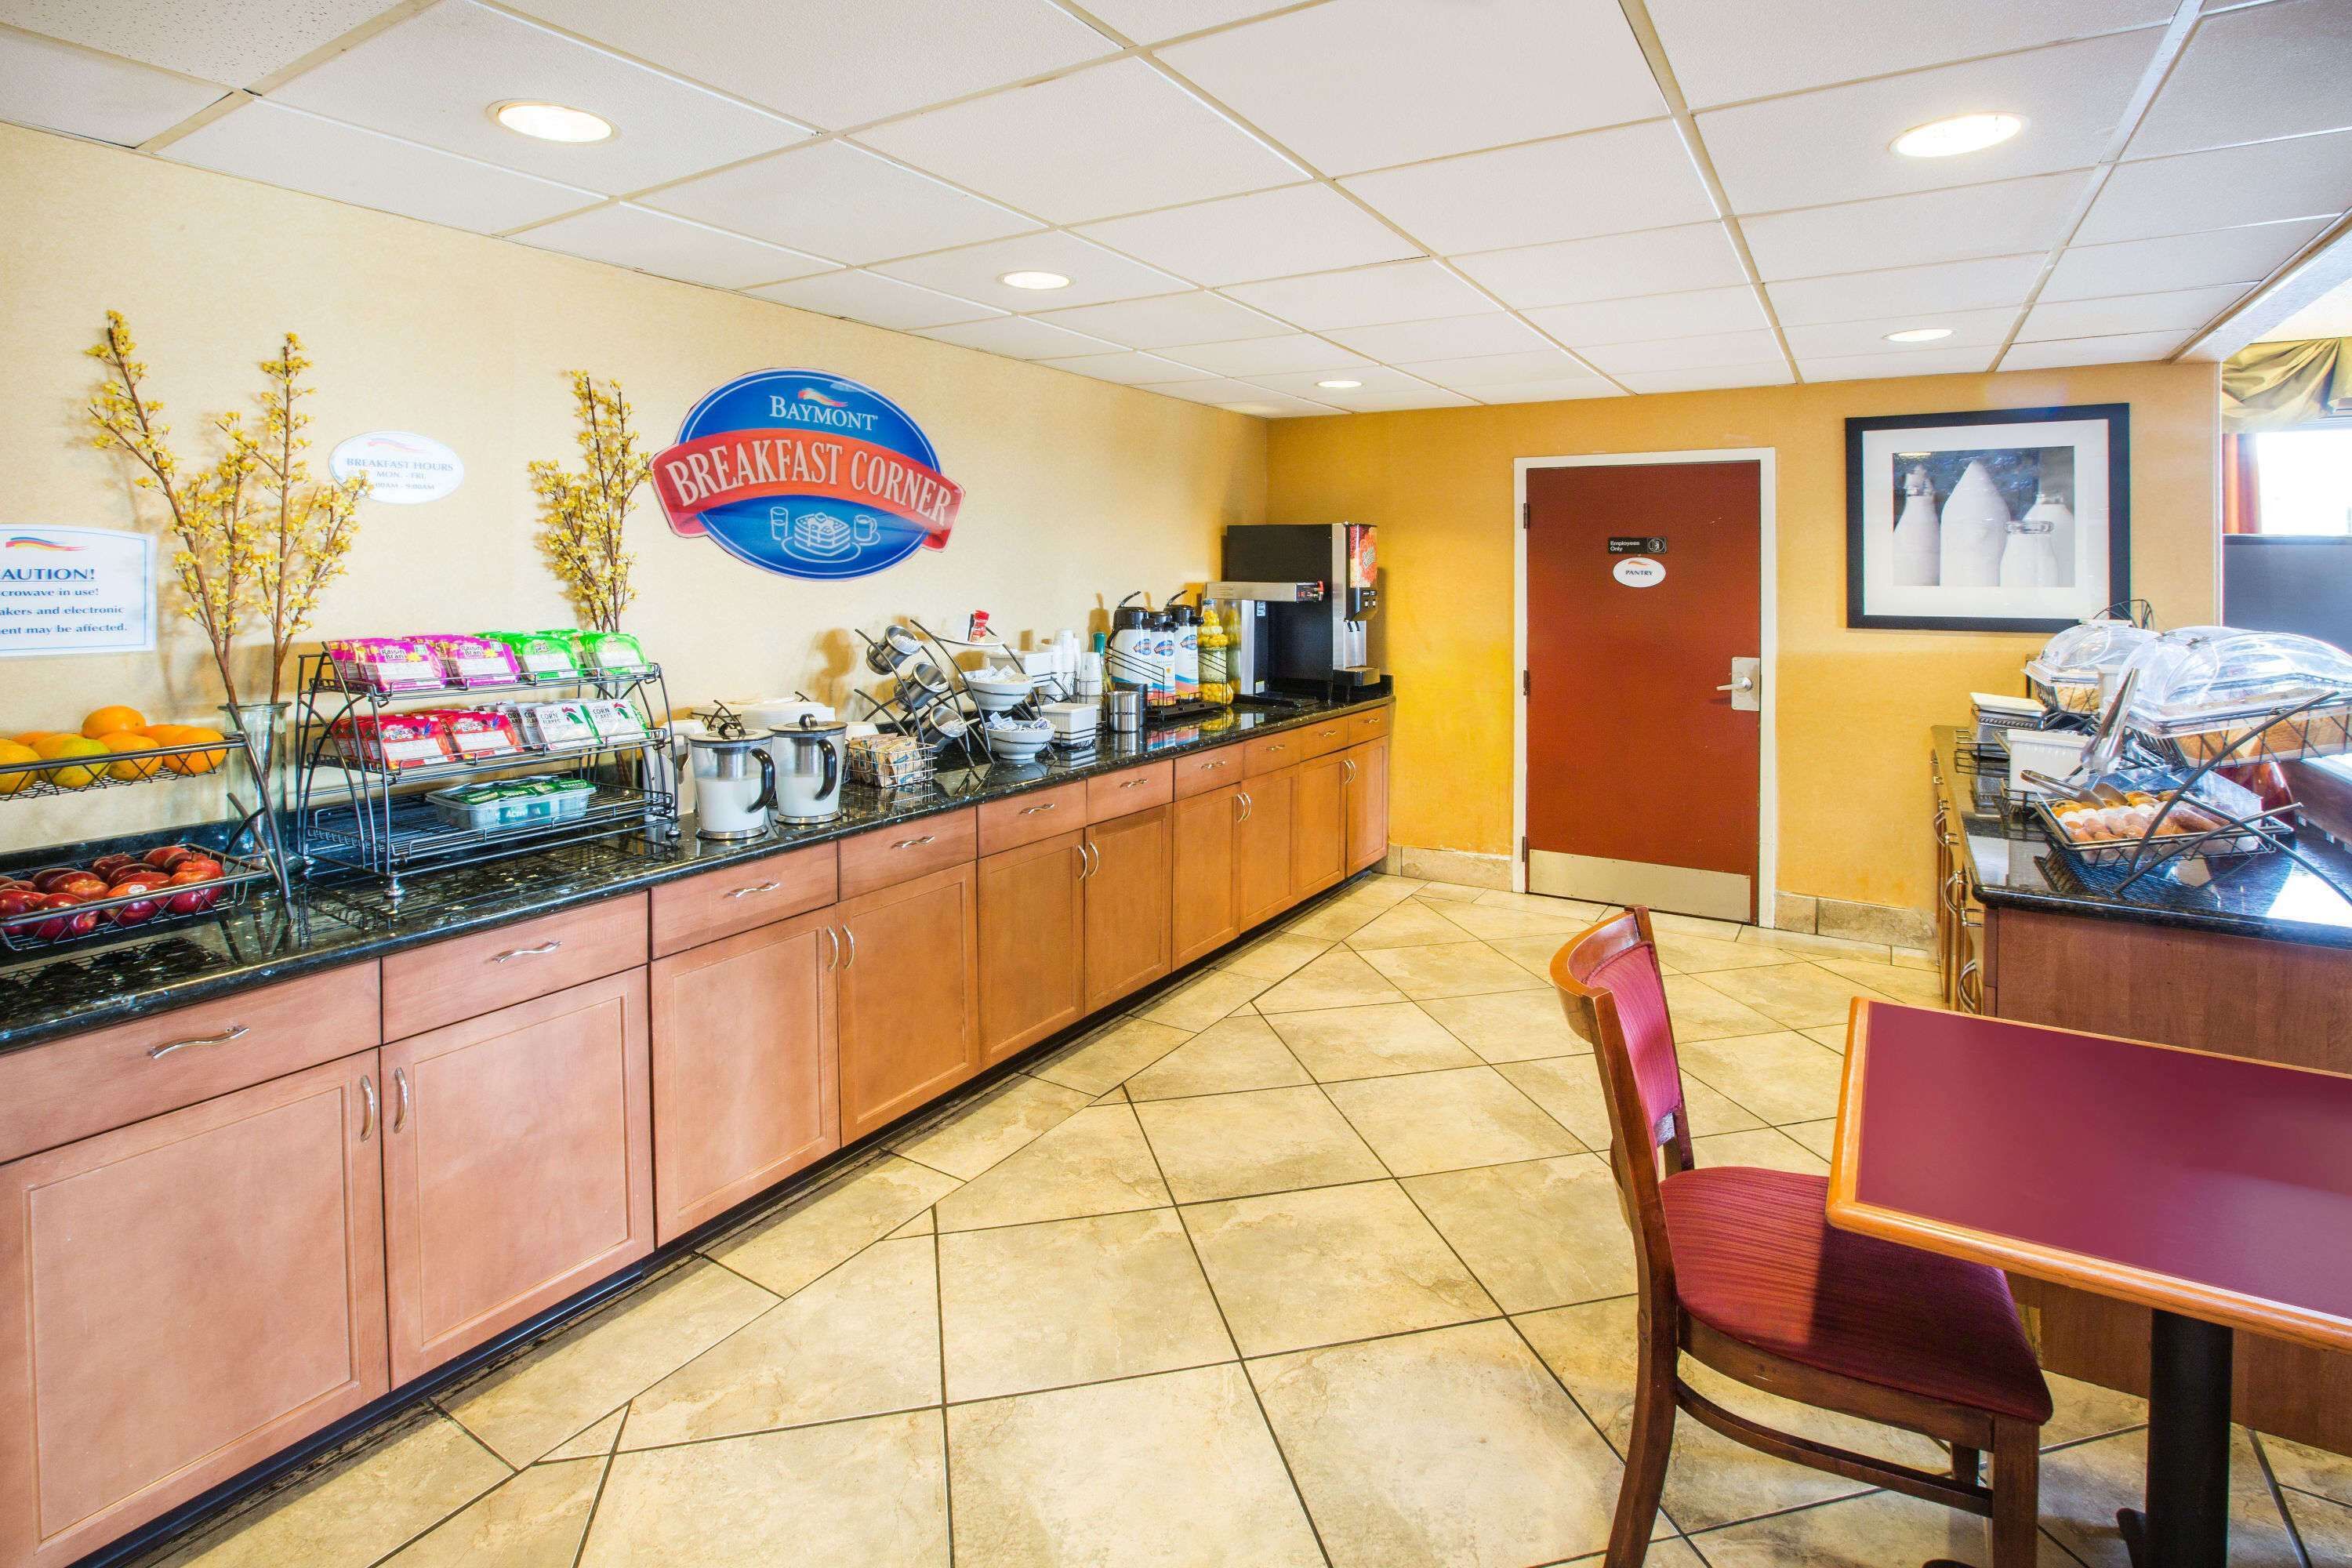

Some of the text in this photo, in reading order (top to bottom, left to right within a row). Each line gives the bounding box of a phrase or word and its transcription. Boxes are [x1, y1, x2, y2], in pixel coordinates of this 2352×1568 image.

[769, 394, 877, 431] BAYMONT
[346, 458, 454, 472] BREAKFAST HOURS
[665, 439, 953, 526] BREAKFAST CORNER
[1, 568, 95, 579] AUTION!
[37, 606, 60, 615] and
[64, 605, 125, 615] electronic
[76, 623, 128, 633] affected.
